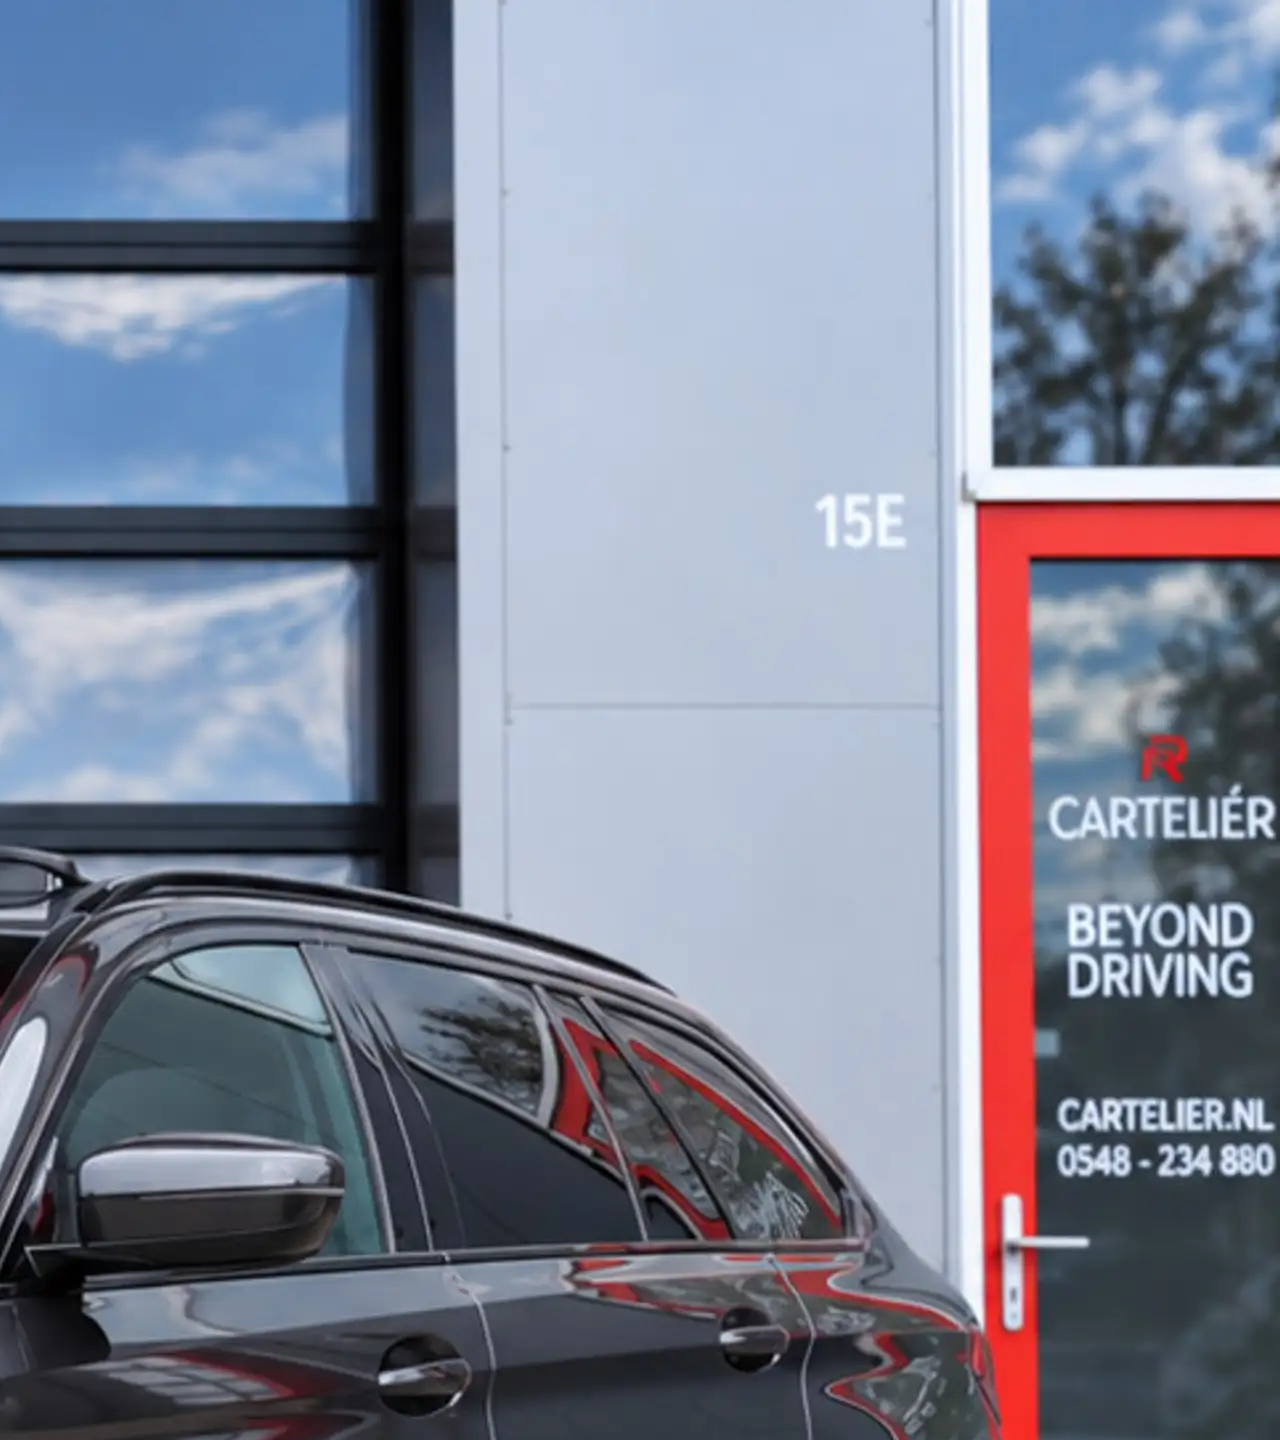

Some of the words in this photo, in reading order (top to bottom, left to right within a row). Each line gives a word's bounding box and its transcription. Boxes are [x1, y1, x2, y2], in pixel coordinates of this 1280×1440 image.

[815, 494, 907, 549] 15E
[1048, 785, 1276, 841] CARTELIÉR
[1067, 902, 1254, 948] BEYOND
[1067, 953, 1254, 998] DRIVING
[1057, 1097, 1276, 1133] CARTELIER.NL
[1057, 1143, 1132, 1178] 0548
[1157, 1143, 1213, 1178] 234
[1218, 1143, 1276, 1177] 880
